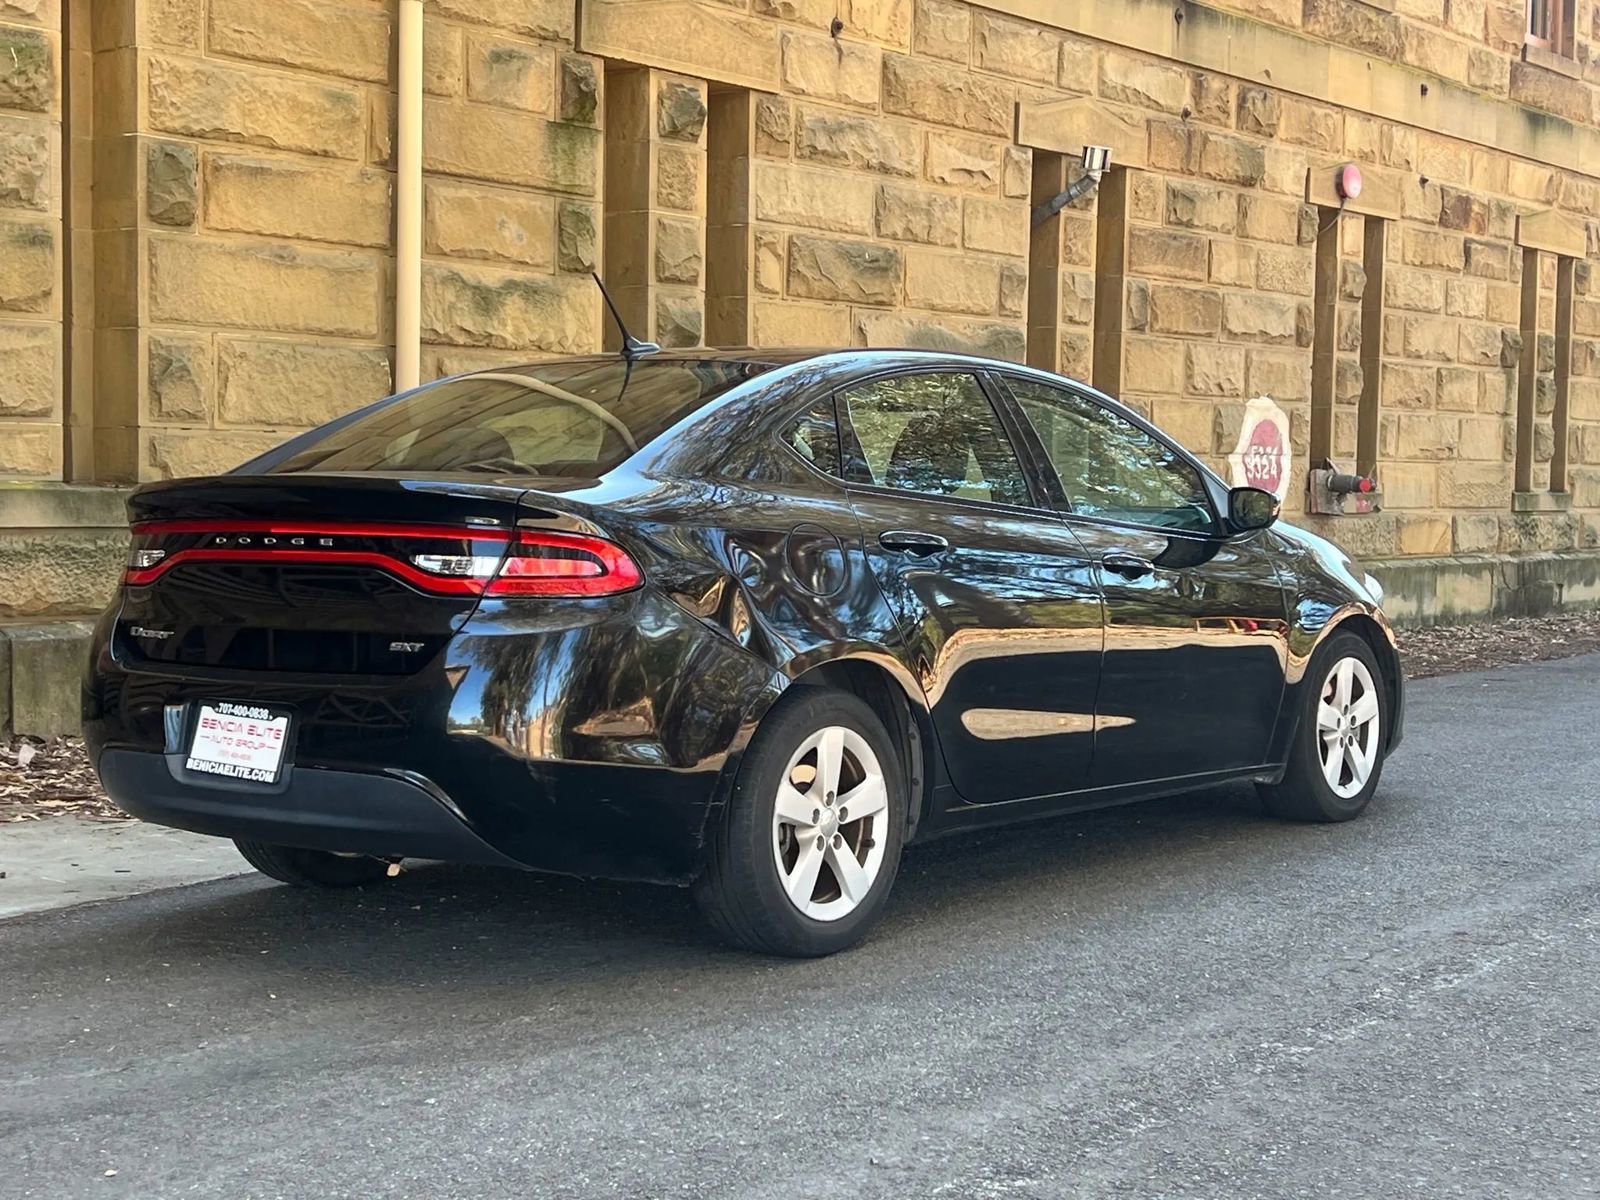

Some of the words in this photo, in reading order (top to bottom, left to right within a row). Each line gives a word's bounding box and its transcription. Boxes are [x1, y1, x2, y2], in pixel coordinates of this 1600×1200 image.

[215, 537, 334, 547] DODGE
[389, 642, 424, 652] SXT
[247, 724, 283, 740] ELITE
[210, 735, 233, 746] AUTO
[235, 738, 266, 750] GROUP
[186, 758, 275, 783] BENICIAELITE.COM
